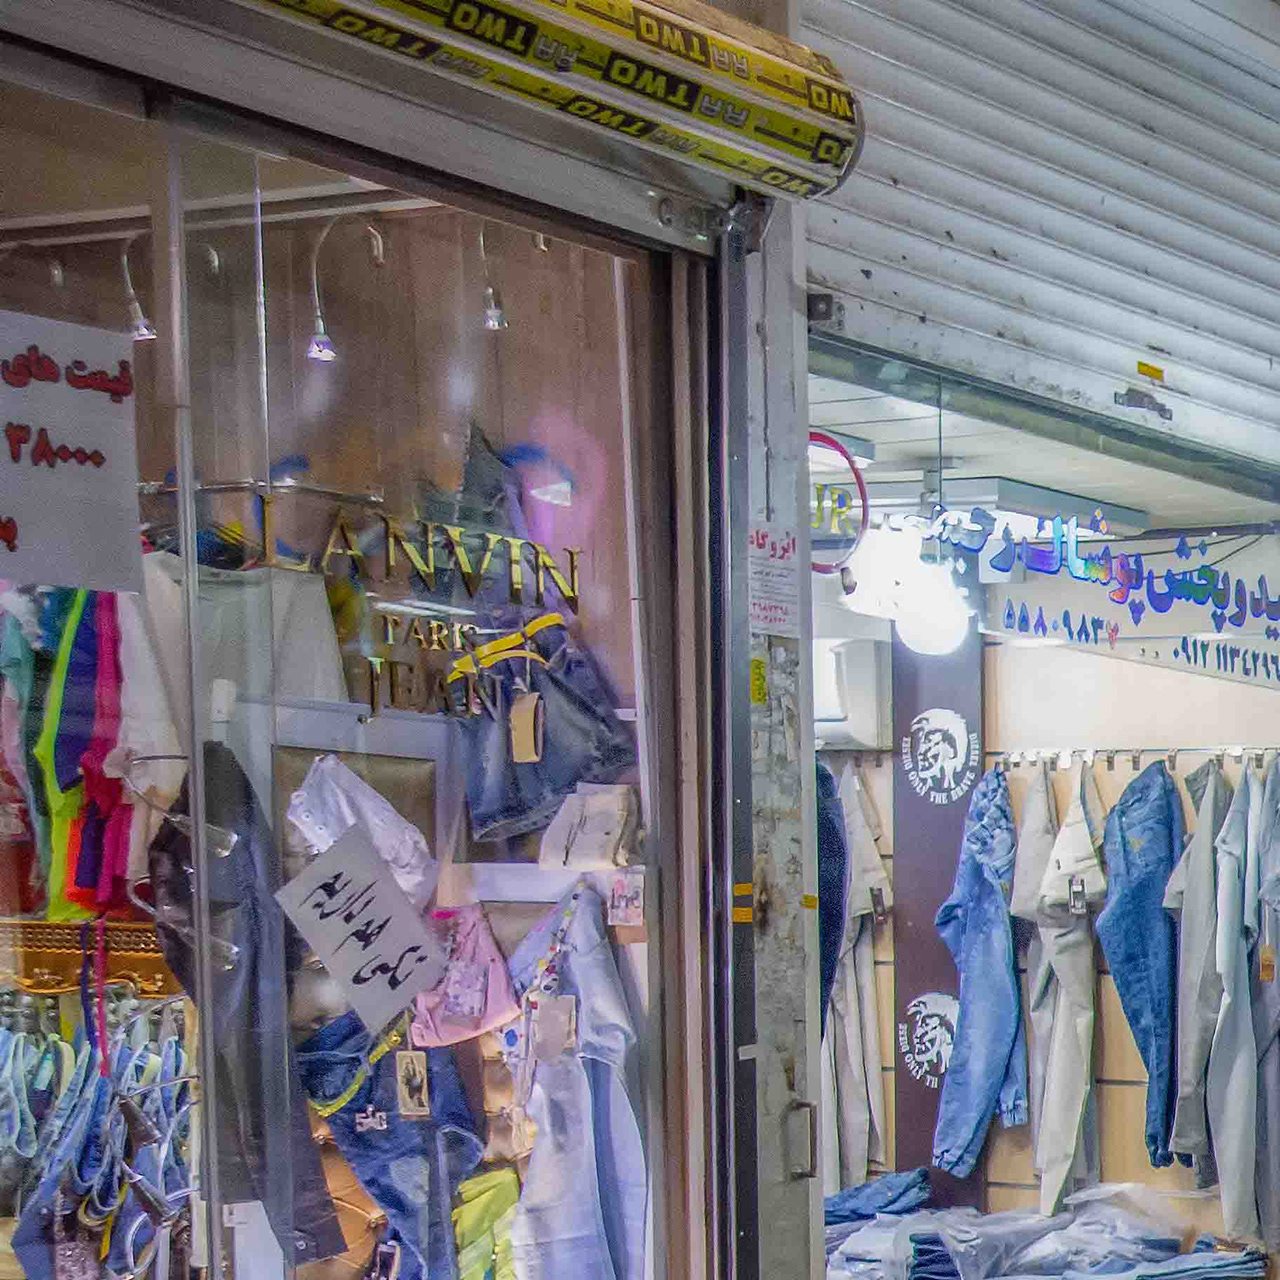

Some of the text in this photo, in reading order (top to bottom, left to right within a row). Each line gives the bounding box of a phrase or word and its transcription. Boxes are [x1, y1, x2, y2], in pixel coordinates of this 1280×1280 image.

[452, 2, 530, 51] TWO
[638, 14, 707, 62] TWO
[609, 58, 691, 108] TWO
[255, 493, 584, 616] LANVIN
[1019, 506, 1147, 627] پوشاک
[1146, 535, 1231, 634] پخش
[1227, 577, 1248, 628] و
[929, 791, 949, 804] THE
